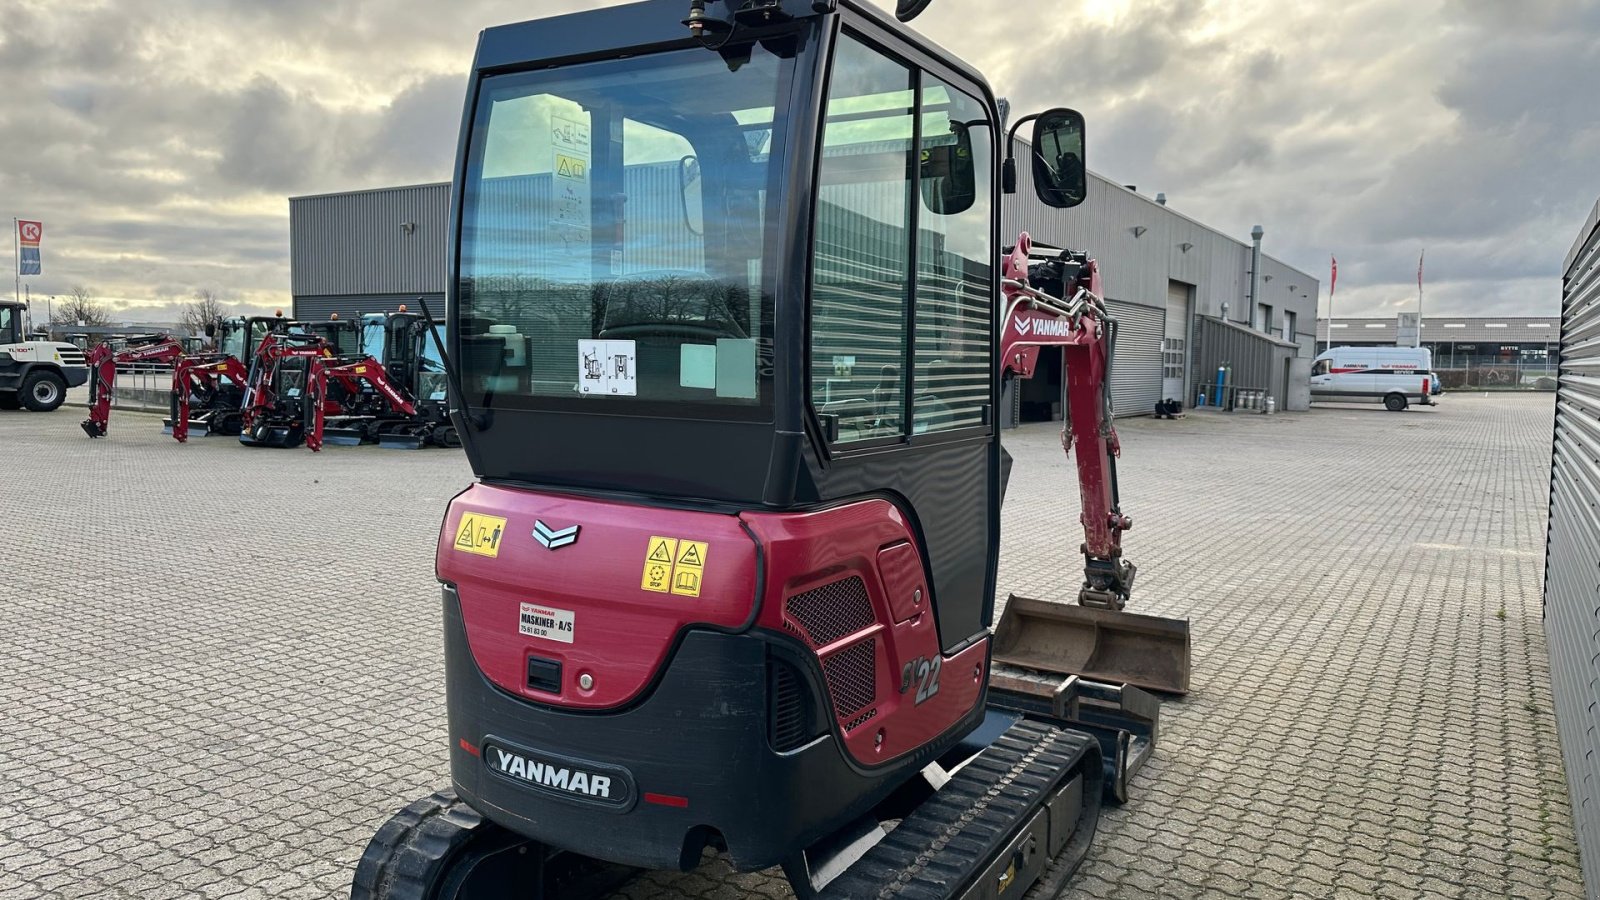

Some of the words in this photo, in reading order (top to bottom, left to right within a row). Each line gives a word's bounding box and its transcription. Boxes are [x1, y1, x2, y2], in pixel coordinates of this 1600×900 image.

[1032, 318, 1070, 336] YANMAR
[143, 346, 169, 357] YANMAR
[384, 383, 404, 404] YANMAR
[530, 608, 555, 617] YANMAR
[521, 613, 555, 629] MASKINER
[558, 620, 573, 632] A/S
[497, 749, 611, 797] YANMAR
